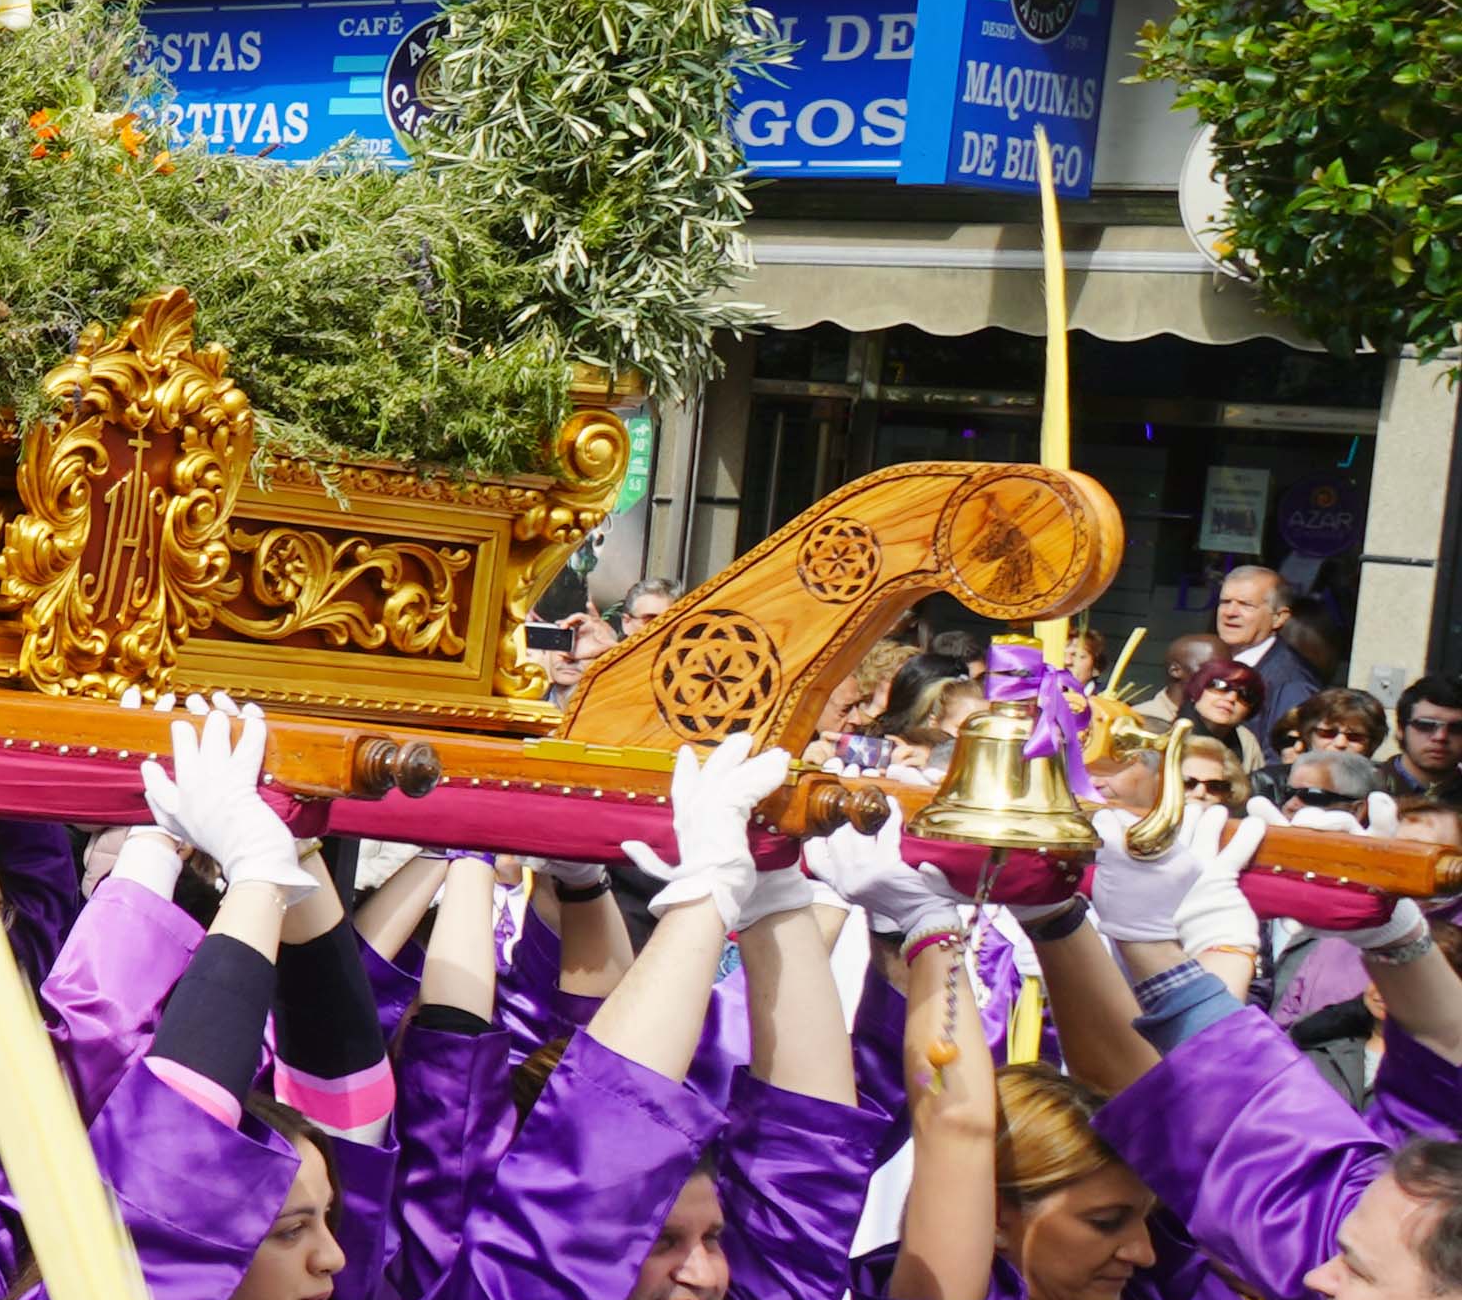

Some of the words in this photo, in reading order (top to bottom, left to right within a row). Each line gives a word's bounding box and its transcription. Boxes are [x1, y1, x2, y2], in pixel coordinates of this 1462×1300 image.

[338, 11, 404, 38] CAFÉ
[821, 13, 918, 62] DE
[981, 20, 1017, 40] DESDE
[962, 60, 1097, 121] MAQUINAS
[958, 131, 999, 177] DE
[1287, 509, 1353, 530] AZAR
